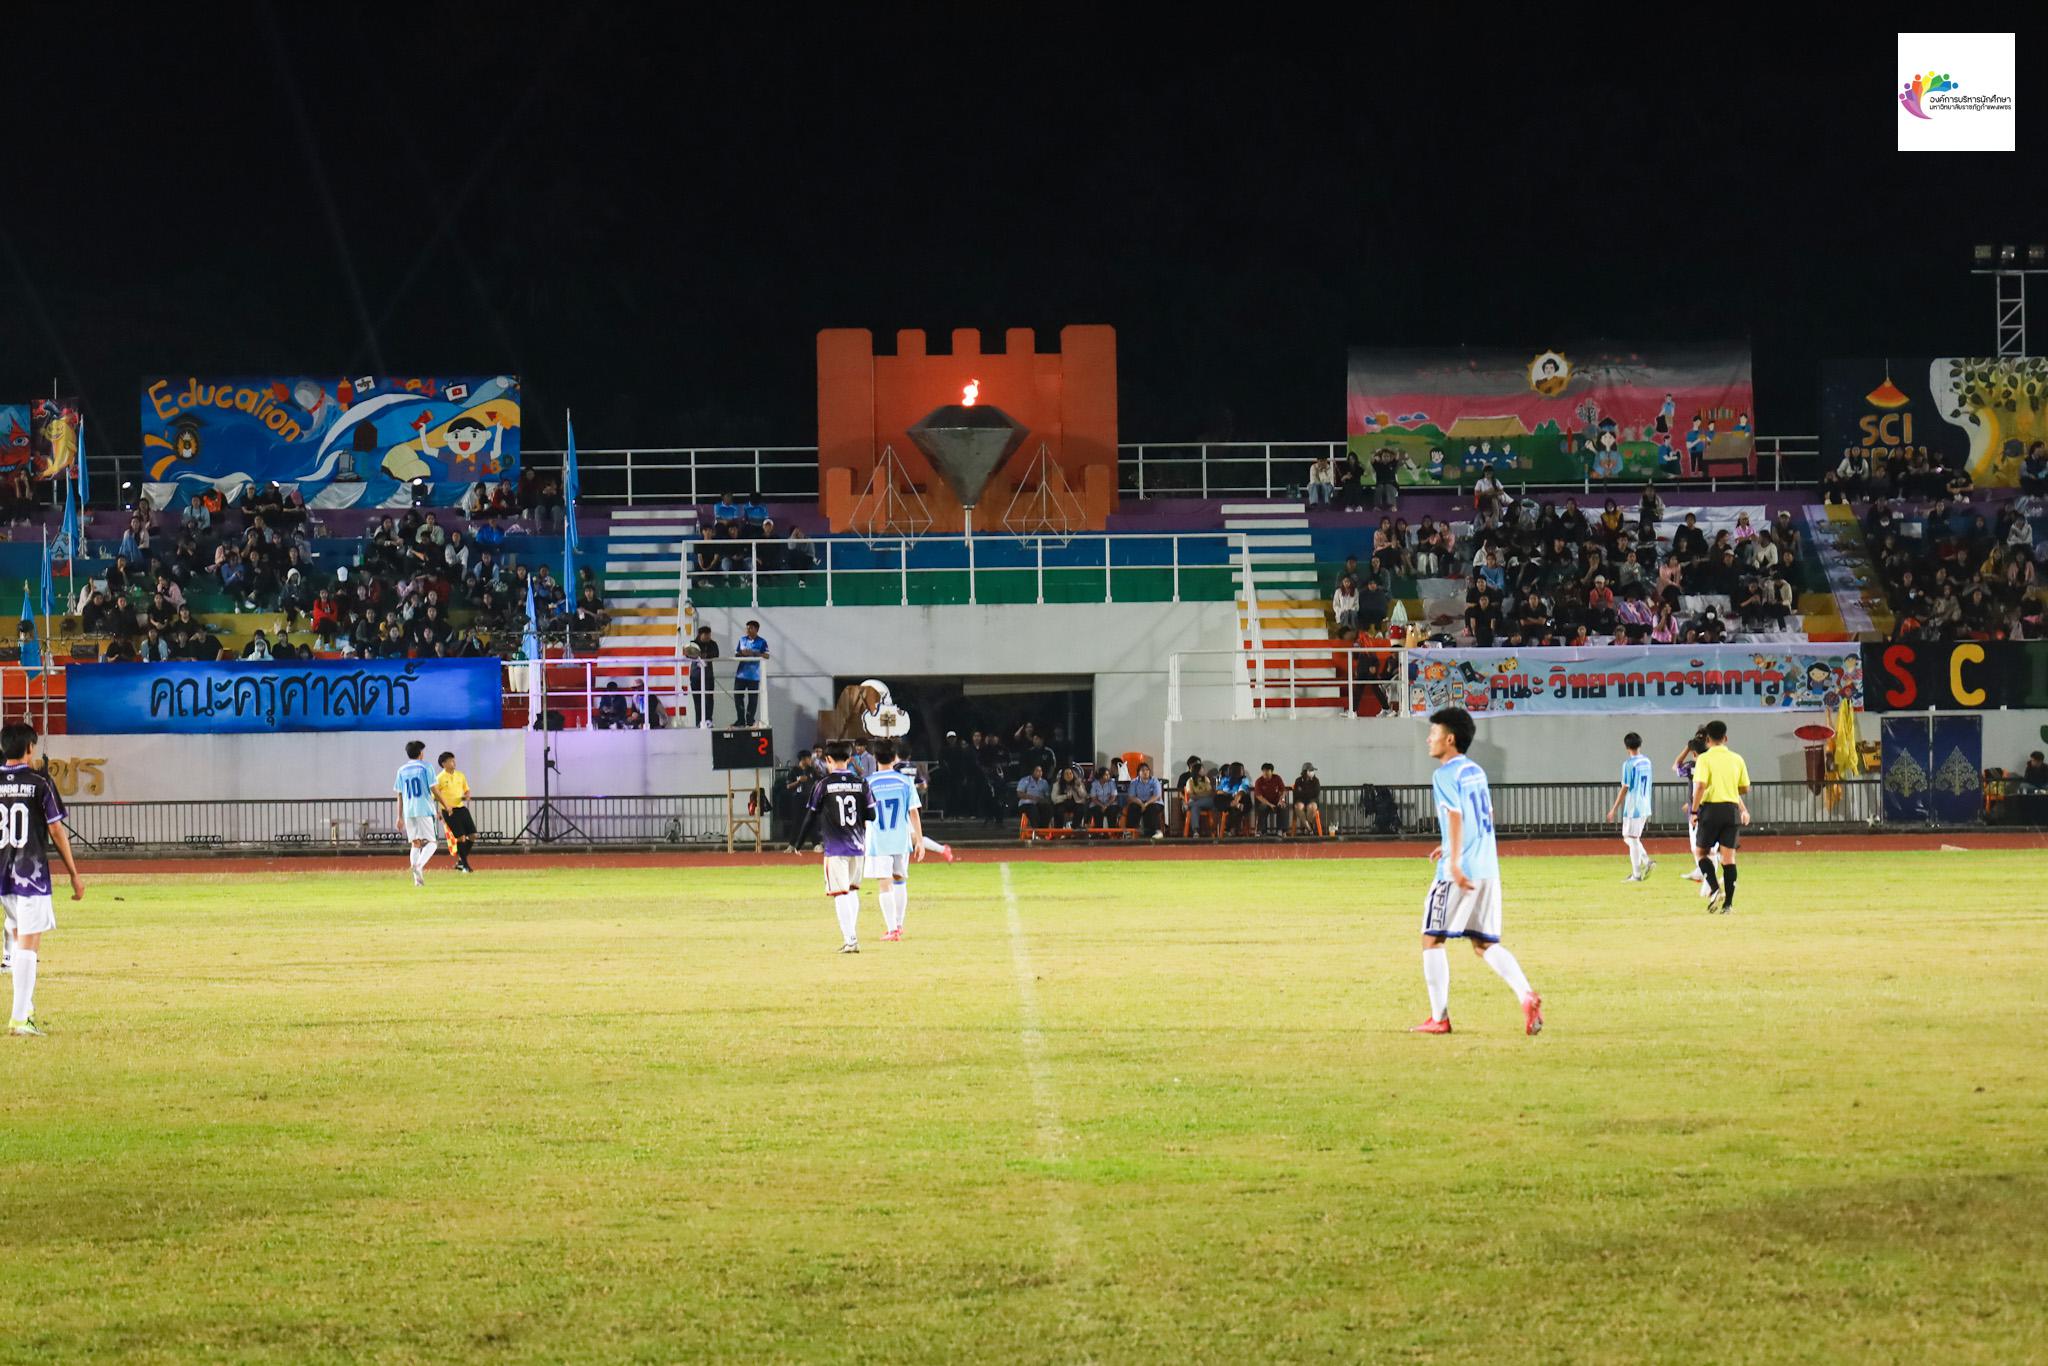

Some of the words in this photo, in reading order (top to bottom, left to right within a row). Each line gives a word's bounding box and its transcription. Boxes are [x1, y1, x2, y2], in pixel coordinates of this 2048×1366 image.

[148, 377, 301, 442] Education
[1858, 412, 1913, 447] SCI
[149, 660, 426, 727] คณะครุศาสตร์
[405, 777, 422, 800] 10
[1640, 775, 1648, 797] 7
[835, 795, 857, 827] 13
[876, 798, 900, 830] 17
[1469, 791, 1494, 839] 19
